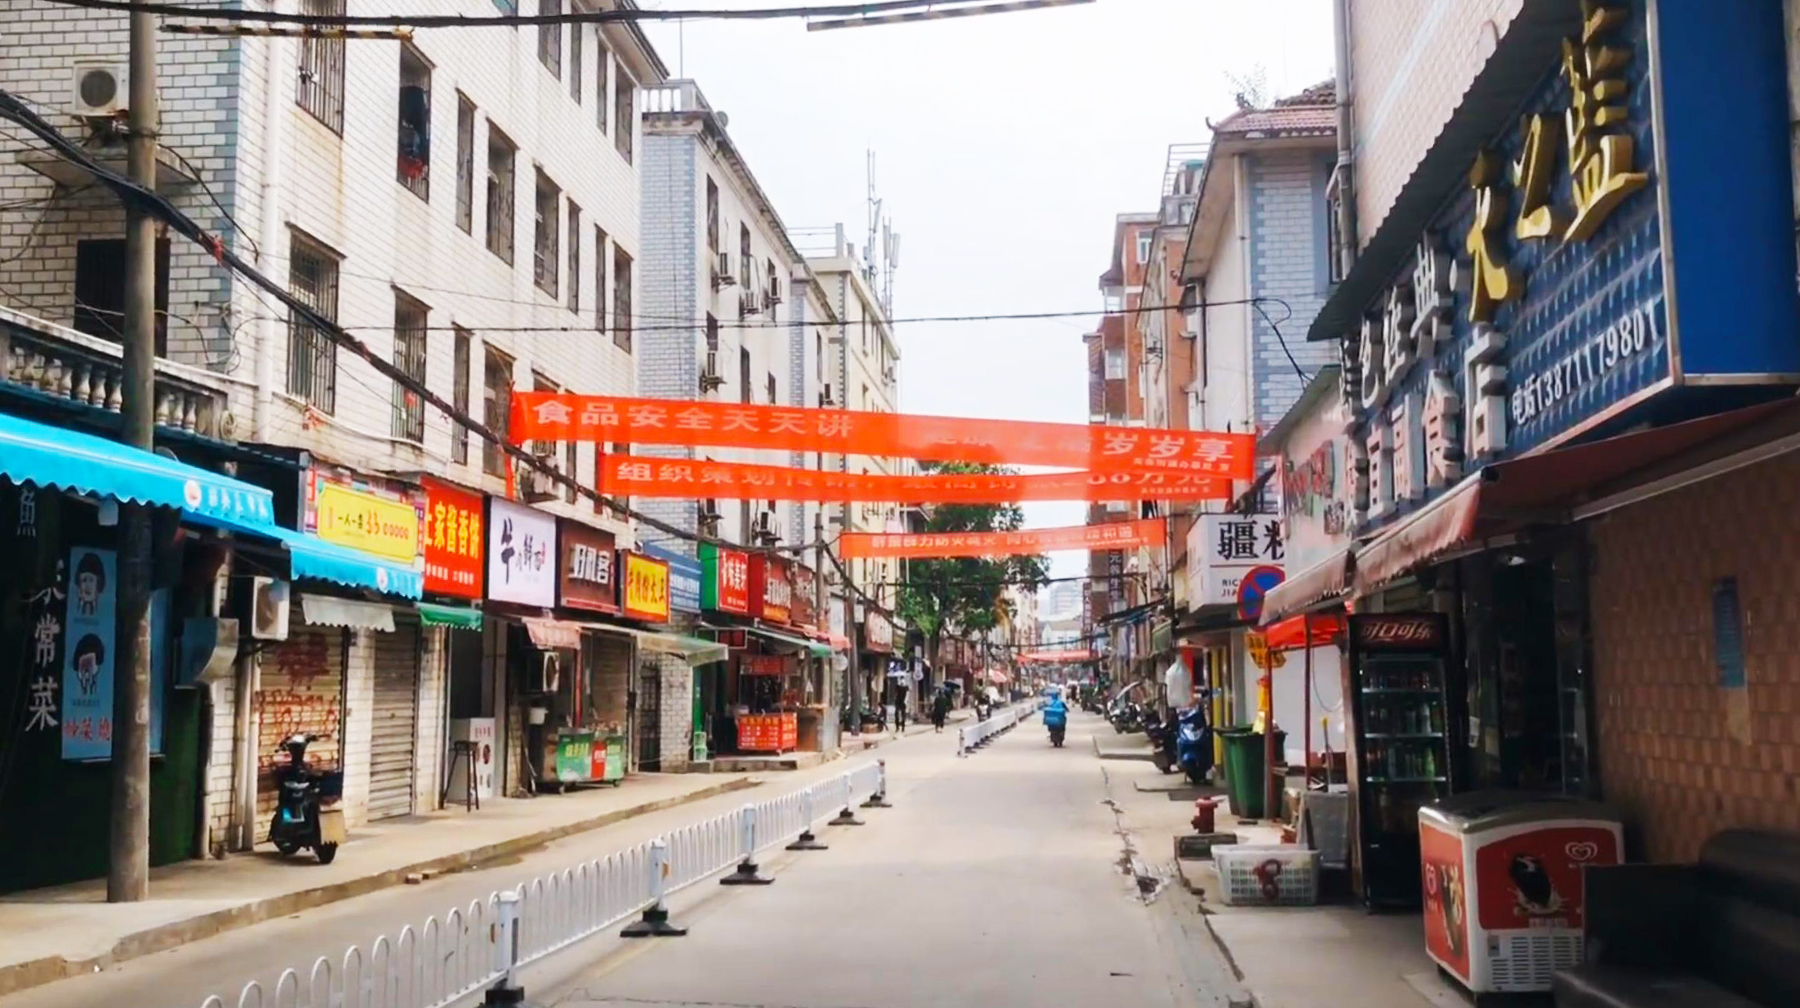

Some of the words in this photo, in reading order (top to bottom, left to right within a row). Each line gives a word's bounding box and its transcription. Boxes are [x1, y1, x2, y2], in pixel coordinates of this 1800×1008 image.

[533, 400, 853, 438] 食品安全天天讲
